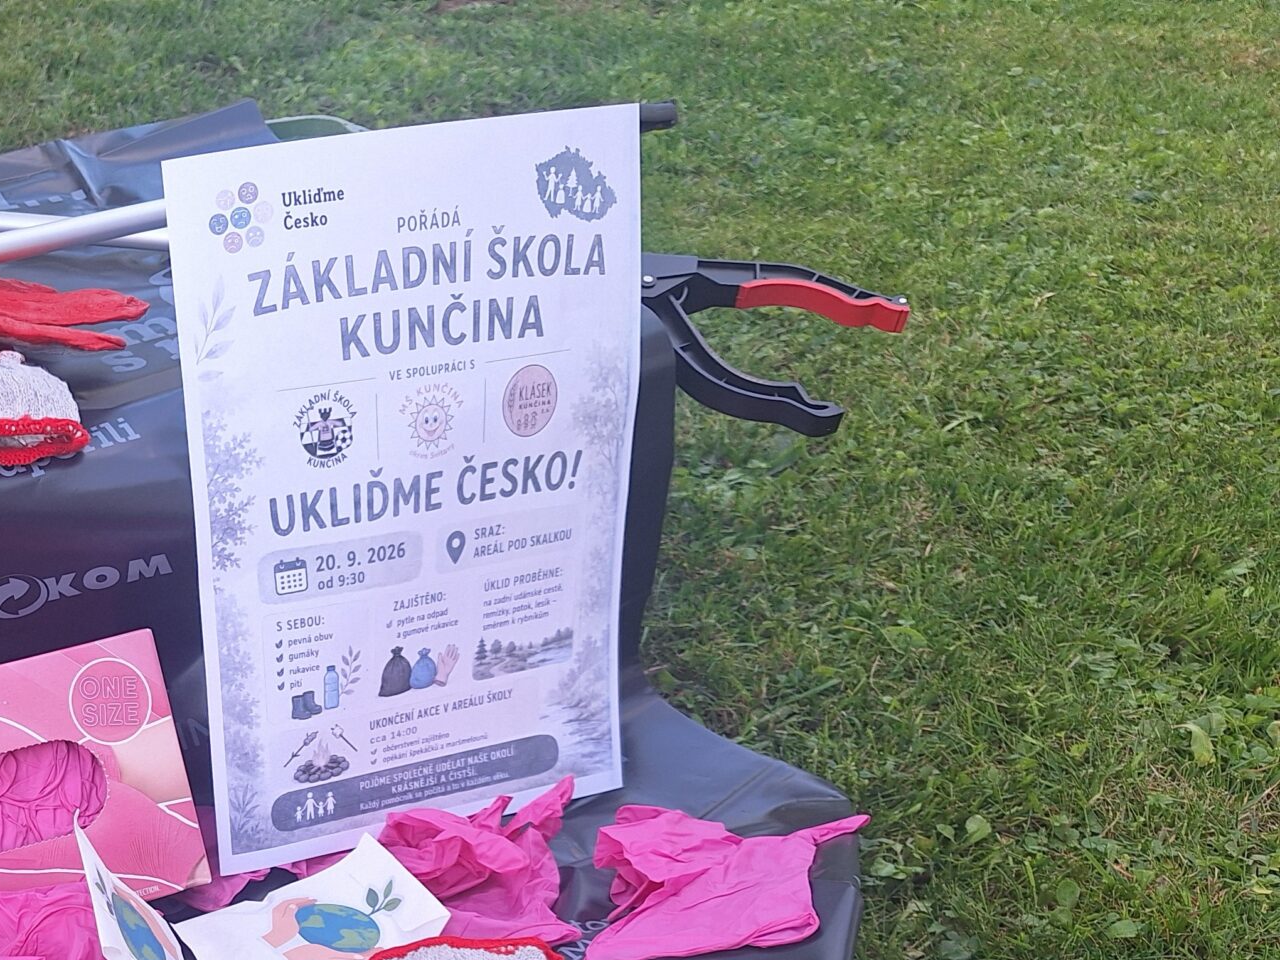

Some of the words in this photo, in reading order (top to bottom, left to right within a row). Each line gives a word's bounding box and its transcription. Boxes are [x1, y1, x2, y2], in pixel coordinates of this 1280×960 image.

[281, 186, 345, 208] Ukliďme
[283, 212, 328, 231] Česko
[397, 205, 462, 234] POŘÁDÁ
[247, 228, 475, 317] ZÁKLADNÍ
[486, 224, 607, 281] ŠKOLA
[339, 293, 544, 361] KUNČINA
[389, 369, 402, 381] VE
[405, 359, 467, 380] SPOLUPRÁCI
[470, 360, 476, 370] S
[416, 382, 465, 408] KUNČINA
[518, 381, 553, 402] KLÁSEK
[332, 390, 358, 419] ŠKOLA
[518, 399, 551, 410] KUNČINA
[306, 452, 348, 469] KUNČINA
[269, 466, 444, 537] UKLIĎME
[456, 450, 583, 506] ČESKO!
[474, 524, 506, 540] SRAZ:
[473, 540, 505, 558] AREÁL
[507, 537, 527, 551] POD
[529, 528, 572, 547] SKALKOU
[315, 553, 341, 573] 20.
[346, 550, 361, 567] 9.
[367, 542, 406, 564] 2026
[317, 577, 334, 591] od
[337, 571, 365, 588] 9:30
[483, 577, 511, 592] ÚKLID
[513, 566, 564, 587] PROBĚHNE:
[392, 591, 447, 612] ZAJIŠTĚNO:
[276, 620, 283, 632] S
[286, 615, 326, 631] SEBOU:
[396, 615, 415, 628] pytle
[416, 614, 426, 622] na
[426, 608, 449, 621] odpad
[287, 634, 312, 648] pevná
[313, 631, 334, 642] obuv
[402, 625, 430, 640] gumové
[430, 618, 460, 632] rukavice
[288, 648, 320, 663] gumáky
[289, 663, 321, 675] rukavice
[78, 675, 139, 700] ONE
[289, 679, 303, 691] pití
[81, 701, 142, 727] SIZE
[369, 707, 415, 731] UKONČENÍ
[416, 704, 441, 720] AKCE
[443, 702, 450, 713] V
[451, 694, 485, 711] AREÁLU
[486, 688, 513, 704] ŠKOLY
[369, 734, 387, 744] cca
[389, 726, 418, 740] 14:00
[359, 774, 391, 791] POJĎME
[392, 765, 435, 783] SPOLEČNĚ
[435, 757, 466, 773] UDĚLAT
[467, 751, 489, 765] NAŠE
[490, 745, 514, 761] OKOLÍ
[391, 777, 439, 794] KRÁSNĚJŠÍ
[439, 775, 447, 783] A
[359, 800, 380, 812] Každý
[380, 792, 413, 808] pomocník
